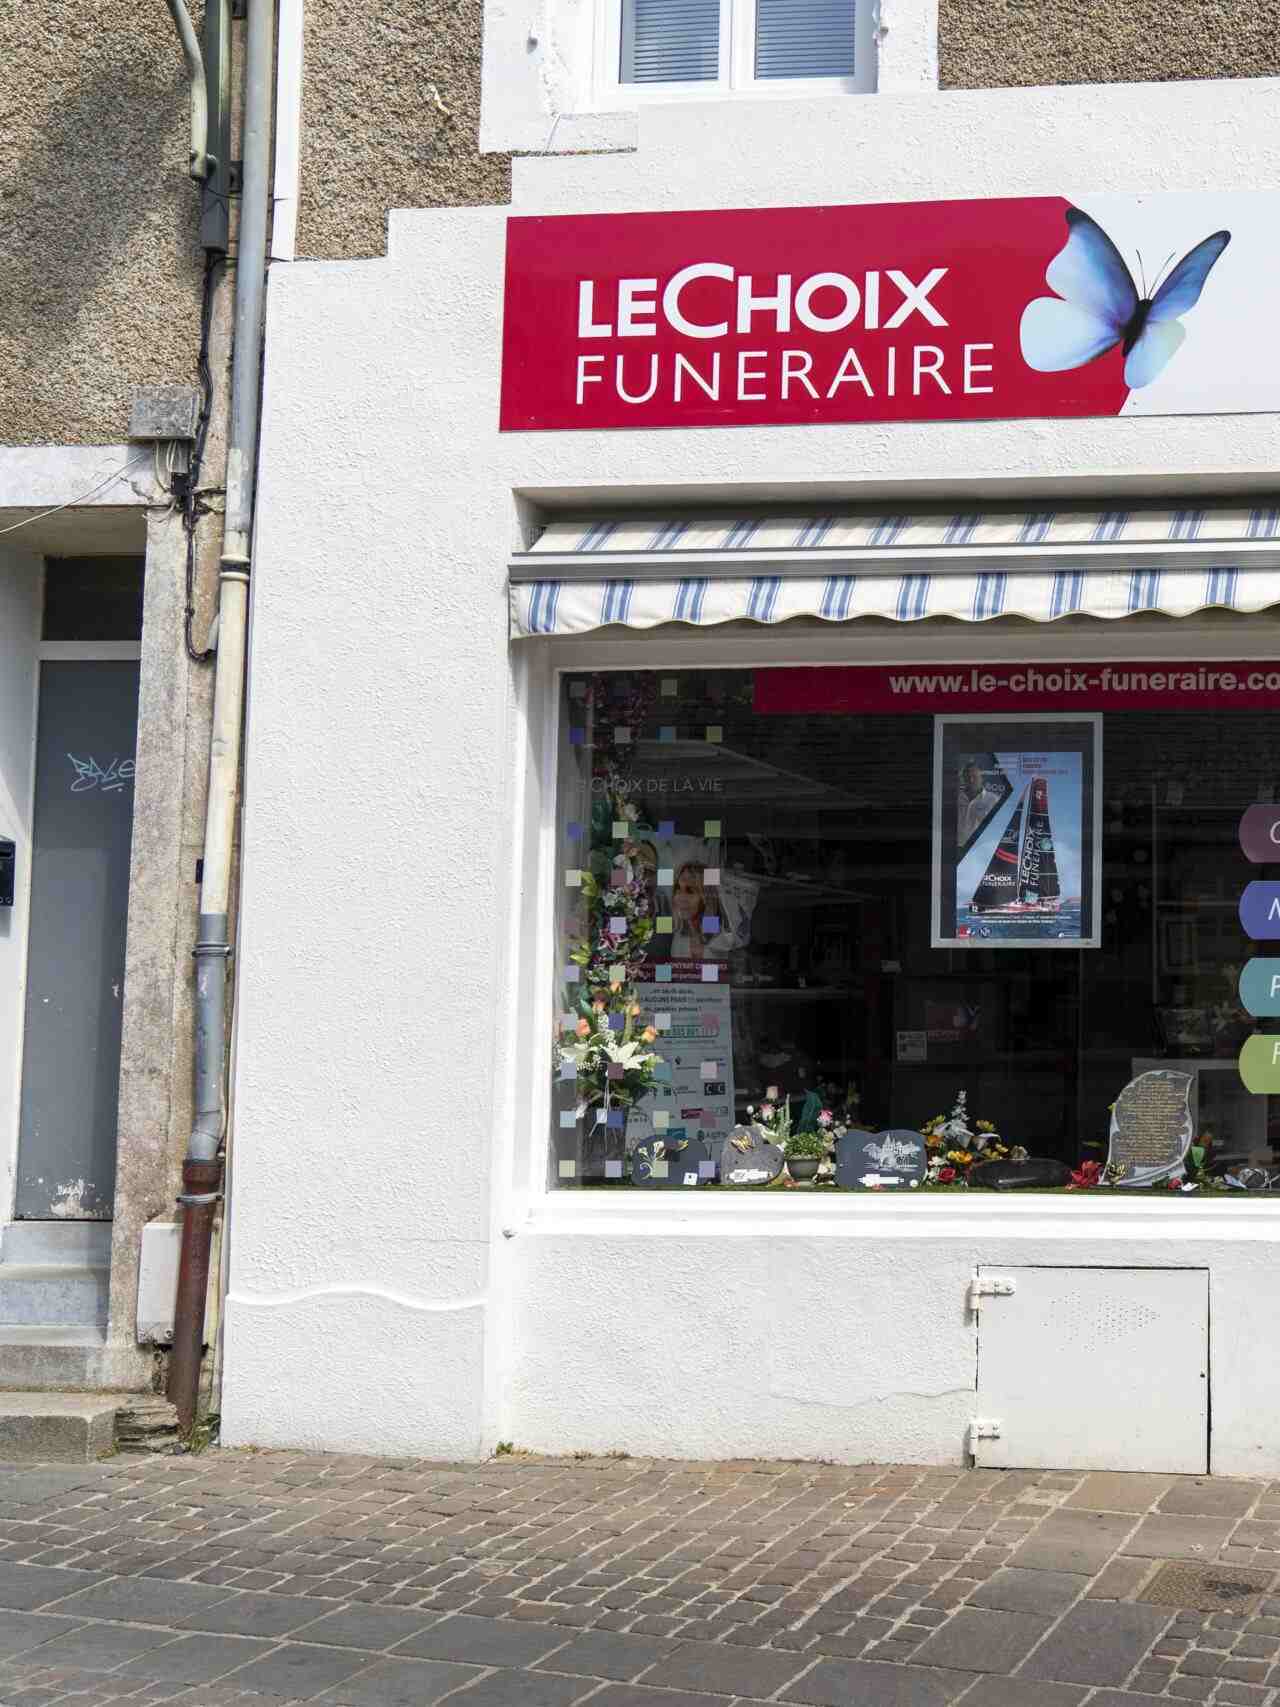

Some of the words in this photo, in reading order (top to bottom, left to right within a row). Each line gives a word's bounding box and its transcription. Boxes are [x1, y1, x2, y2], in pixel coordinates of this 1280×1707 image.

[575, 343, 994, 405] FUNERAIRE
[591, 777, 642, 793] CHOIX
[647, 777, 669, 792] DE
[672, 777, 694, 792] LA
[697, 777, 723, 792] VIE
